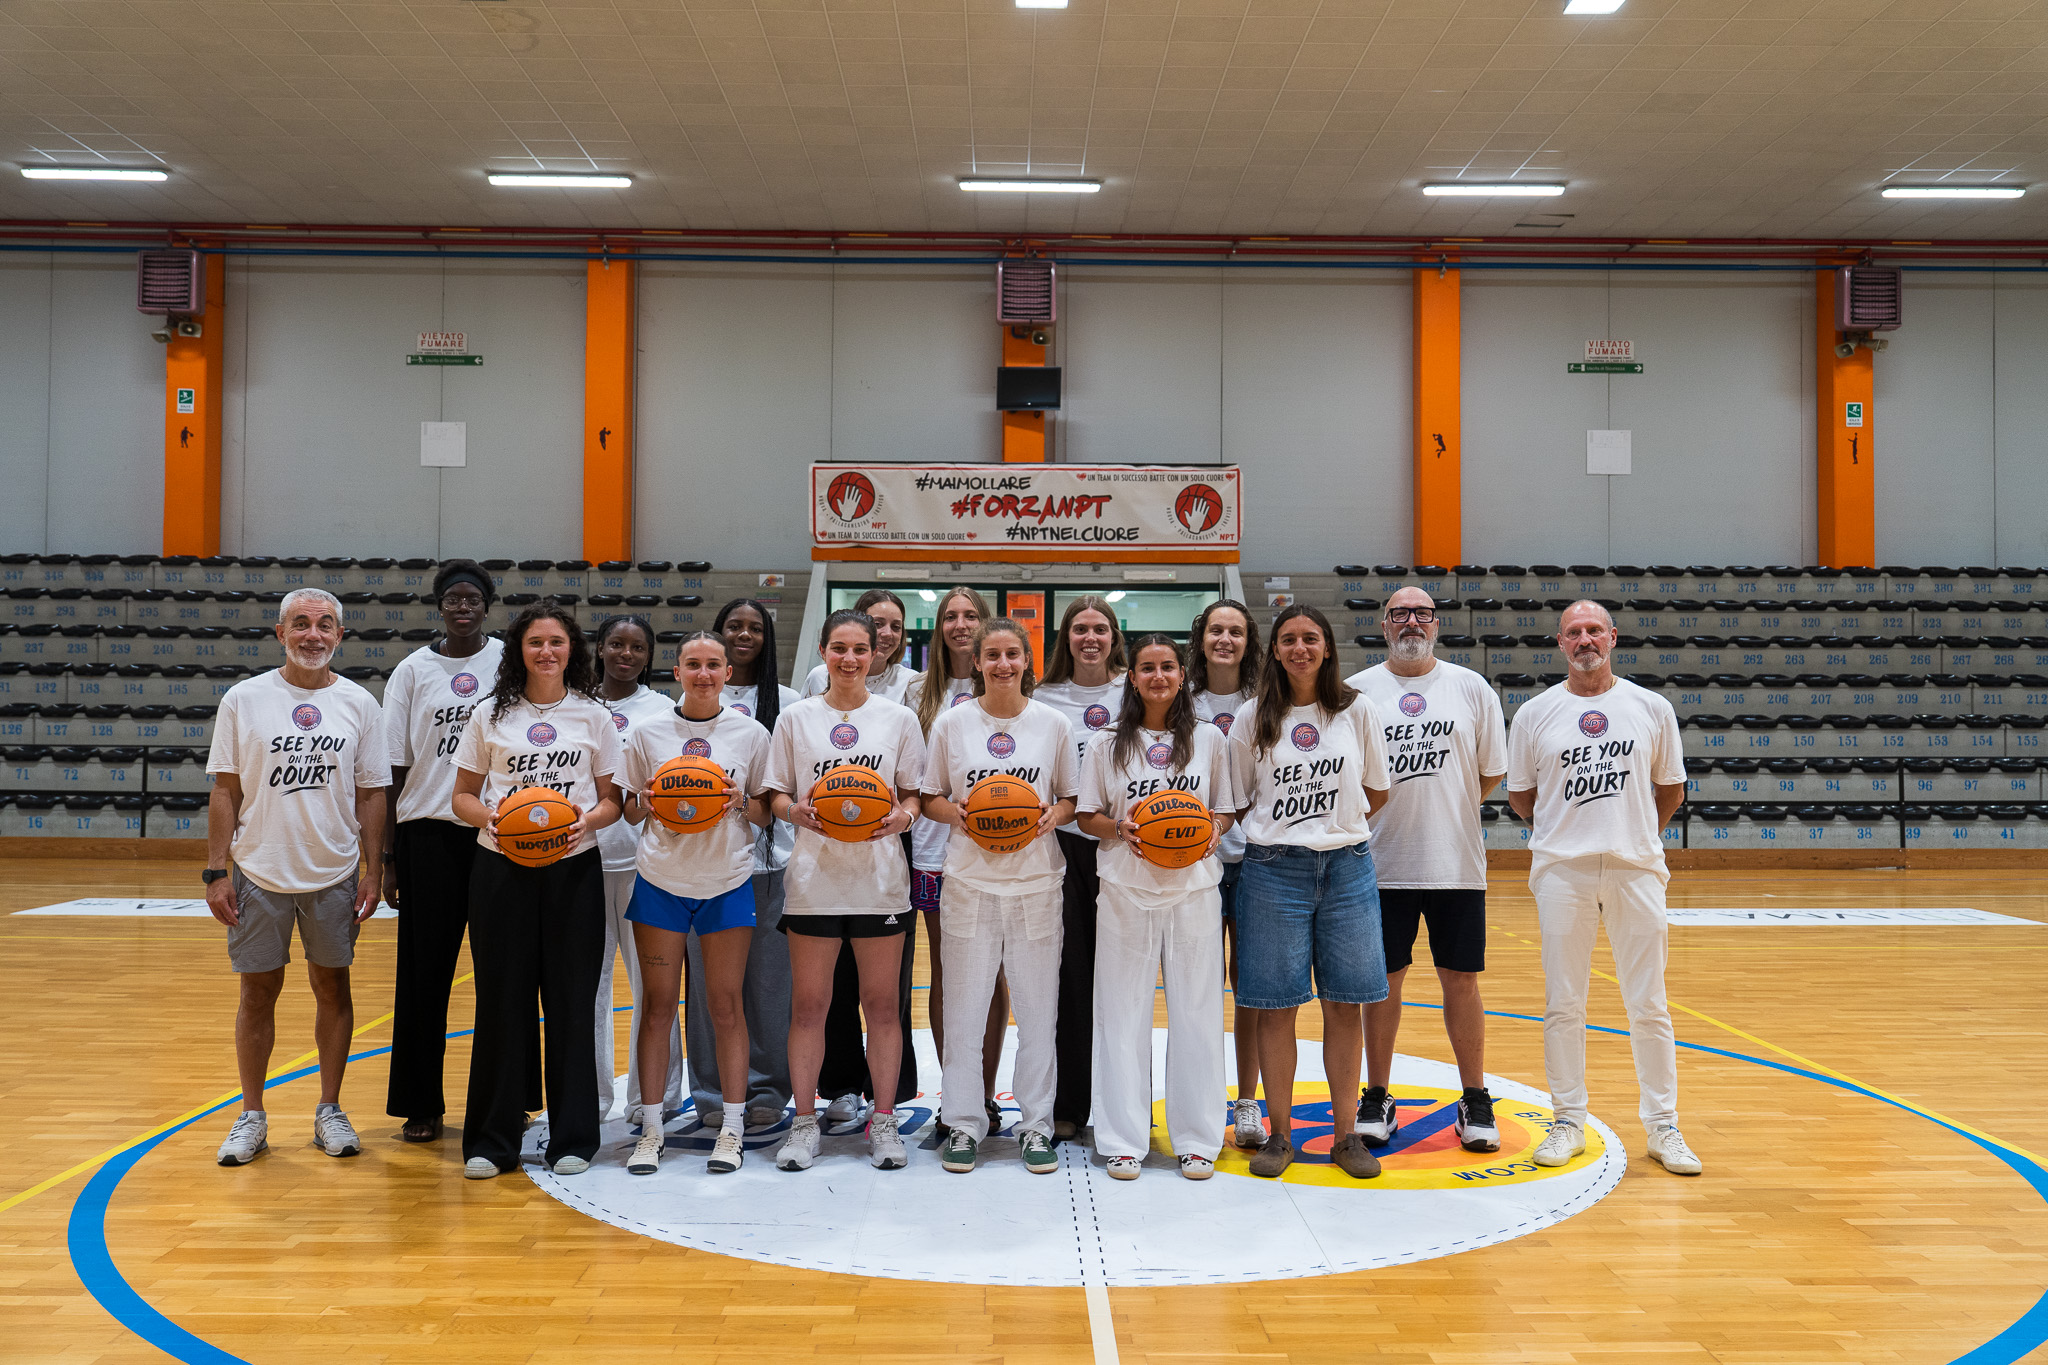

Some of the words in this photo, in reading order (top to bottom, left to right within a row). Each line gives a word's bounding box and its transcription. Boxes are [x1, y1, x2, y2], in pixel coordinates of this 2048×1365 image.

[422, 332, 464, 340] VIETATO
[420, 340, 464, 348] FUMARE
[1588, 340, 1630, 348] VIETATO
[915, 472, 1031, 491] #MAIMOLLARE
[950, 493, 1112, 525] #FORZANPT
[862, 532, 889, 540] SUCCESSO
[890, 532, 906, 540] BATTE
[908, 532, 919, 540] CON
[1006, 522, 1139, 541] #NPTNELCUORE
[524, 577, 543, 587] 360
[564, 577, 582, 587] 361
[604, 578, 622, 588] 362
[644, 578, 662, 588] 363
[684, 579, 702, 589] 364
[1461, 582, 1480, 592] 368
[1502, 582, 1520, 592] 369
[1540, 583, 1560, 592] 370
[456, 680, 474, 688] NPT
[456, 690, 476, 698] TREVISO
[1682, 694, 1702, 704] 204
[1724, 694, 1744, 704] 205
[1768, 694, 1789, 704] 206
[1811, 694, 1831, 704] 207
[1854, 694, 1874, 704] 208
[1897, 694, 1918, 704] 209
[1940, 694, 1961, 704] 210
[1984, 694, 2003, 704] 211
[2027, 694, 2048, 704] 212
[1404, 700, 1423, 708] NPT
[434, 705, 466, 726] SEE
[1088, 713, 1106, 722] NPT
[1403, 708, 1425, 717] TREVISO
[295, 722, 319, 731] TREVISO
[450, 724, 464, 734] ON
[1584, 720, 1604, 728] NPT
[2, 724, 23, 735] 126
[47, 724, 68, 736] 127
[92, 725, 113, 736] 128
[138, 726, 158, 737] 129
[184, 726, 204, 738] 130
[1384, 724, 1414, 742] SEE
[1421, 720, 1454, 739] YOU
[1583, 730, 1606, 738] TREVISO
[270, 735, 304, 754] SEE
[310, 735, 346, 752] YOU
[531, 739, 554, 747] TREVISO
[833, 742, 855, 750] TREVISO
[992, 741, 1012, 749] NPT
[1296, 743, 1317, 752] TREVISO
[1400, 742, 1414, 752] ON
[1417, 741, 1434, 750] THE
[1704, 736, 1725, 747] 148
[1750, 736, 1770, 747] 149
[1794, 736, 1815, 747] 150
[1839, 736, 1859, 747] 151
[1883, 736, 1904, 747] 152
[1928, 736, 1949, 747] 153
[1972, 735, 1993, 747] 154
[2017, 736, 2038, 747] 155
[288, 754, 302, 764] ON
[304, 754, 323, 764] THE
[990, 751, 1013, 759] TREVISO
[1561, 746, 1592, 768] SEE
[1599, 740, 1634, 760] YOU
[507, 753, 539, 774] SEE
[546, 750, 582, 770] YOU
[814, 758, 842, 780] SEE
[849, 754, 882, 770] YOU
[1577, 764, 1592, 775] ON
[1595, 761, 1613, 772] THE
[16, 768, 29, 780] 71
[64, 768, 78, 781] 72
[110, 770, 125, 782] 73
[158, 770, 172, 782] 74
[269, 765, 337, 787] COURT
[522, 773, 538, 784] ON
[540, 771, 560, 781] THE
[1005, 767, 1040, 784] YOU
[1273, 764, 1302, 787] SEE
[1309, 756, 1344, 780] YOU
[661, 774, 713, 790] Wilson
[826, 776, 877, 792] Wilson
[1127, 778, 1160, 800] SEE
[1166, 775, 1200, 791] YOU
[1288, 784, 1302, 795] ON
[1305, 781, 1323, 792] THE
[1565, 770, 1630, 801] COURT
[1686, 780, 1700, 792] 91
[1732, 780, 1748, 792] 92
[1779, 780, 1794, 792] 93
[1825, 780, 1840, 792] 94
[1872, 780, 1887, 791] 95
[1918, 780, 1933, 792] 96
[1964, 780, 1979, 792] 97
[2010, 779, 2026, 790] 98
[1149, 798, 1202, 815] Wilson
[1272, 788, 1338, 821] COURT
[28, 816, 42, 828] 16
[77, 818, 91, 829] 17
[126, 818, 141, 829] 18
[176, 818, 190, 830] 19
[976, 816, 1029, 831] Wilson
[1164, 826, 1196, 839] EVO
[1665, 828, 1679, 840] 34
[1714, 828, 1728, 840] 35
[1761, 828, 1776, 840] 36
[1809, 828, 1823, 840] 37
[1857, 828, 1872, 840] 38
[1906, 828, 1921, 840] 39
[1953, 828, 1968, 839] 40
[2000, 828, 2015, 840] 41
[516, 832, 568, 852] Wilson
[920, 874, 942, 900] 11
